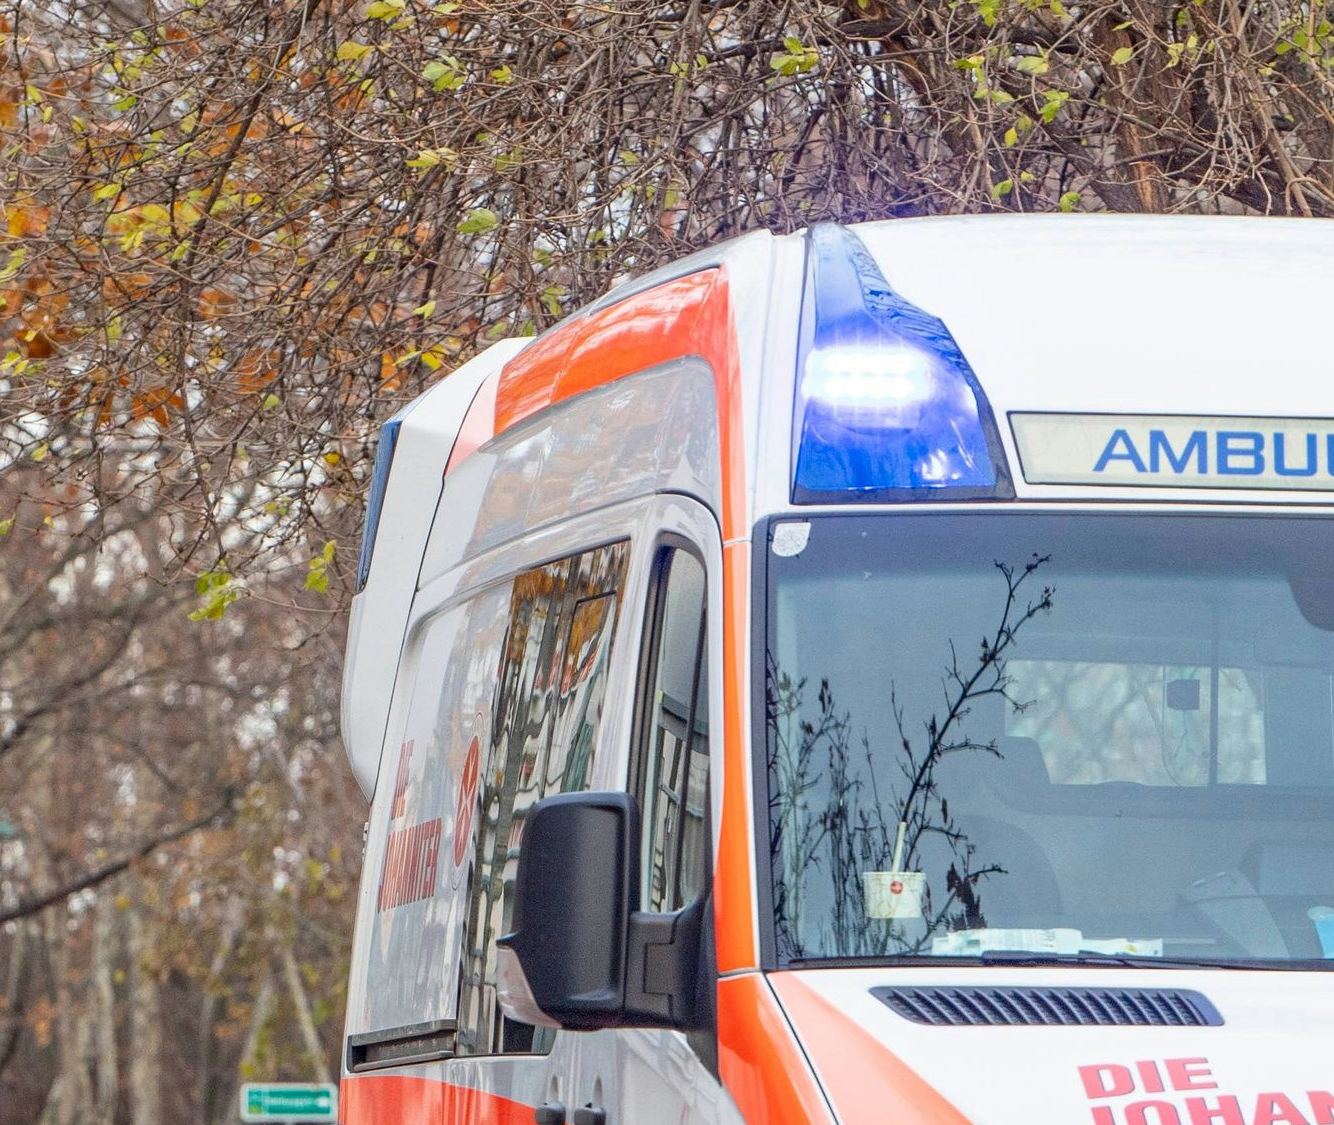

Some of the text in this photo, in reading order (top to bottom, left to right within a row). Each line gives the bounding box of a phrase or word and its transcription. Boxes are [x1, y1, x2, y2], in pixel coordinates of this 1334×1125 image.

[391, 740, 415, 820] DIE
[378, 818, 442, 914] JOHANNITER
[1078, 1057, 1219, 1099] DIE
